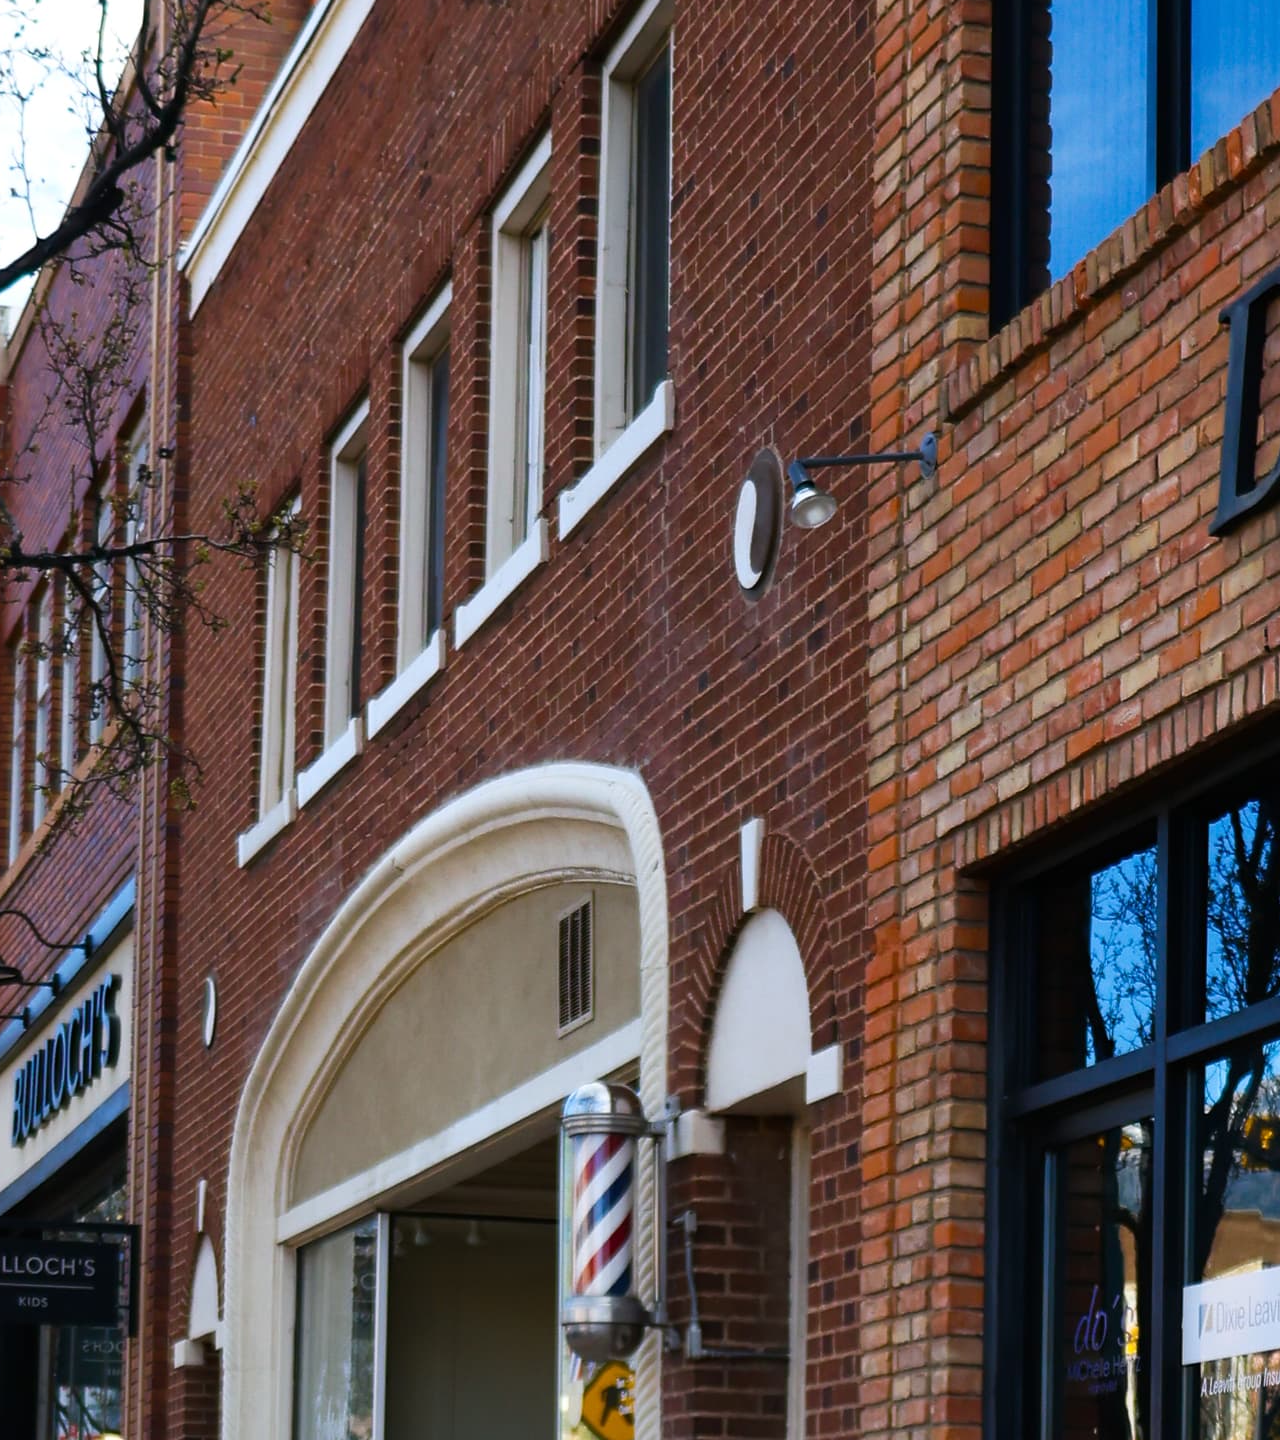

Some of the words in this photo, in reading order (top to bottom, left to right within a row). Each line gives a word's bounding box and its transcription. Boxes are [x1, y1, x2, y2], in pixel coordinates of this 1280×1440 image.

[11, 971, 122, 1149] BULLOCH'S
[18, 1297, 49, 1308] KIDS
[1216, 1300, 1246, 1334] Dixie
